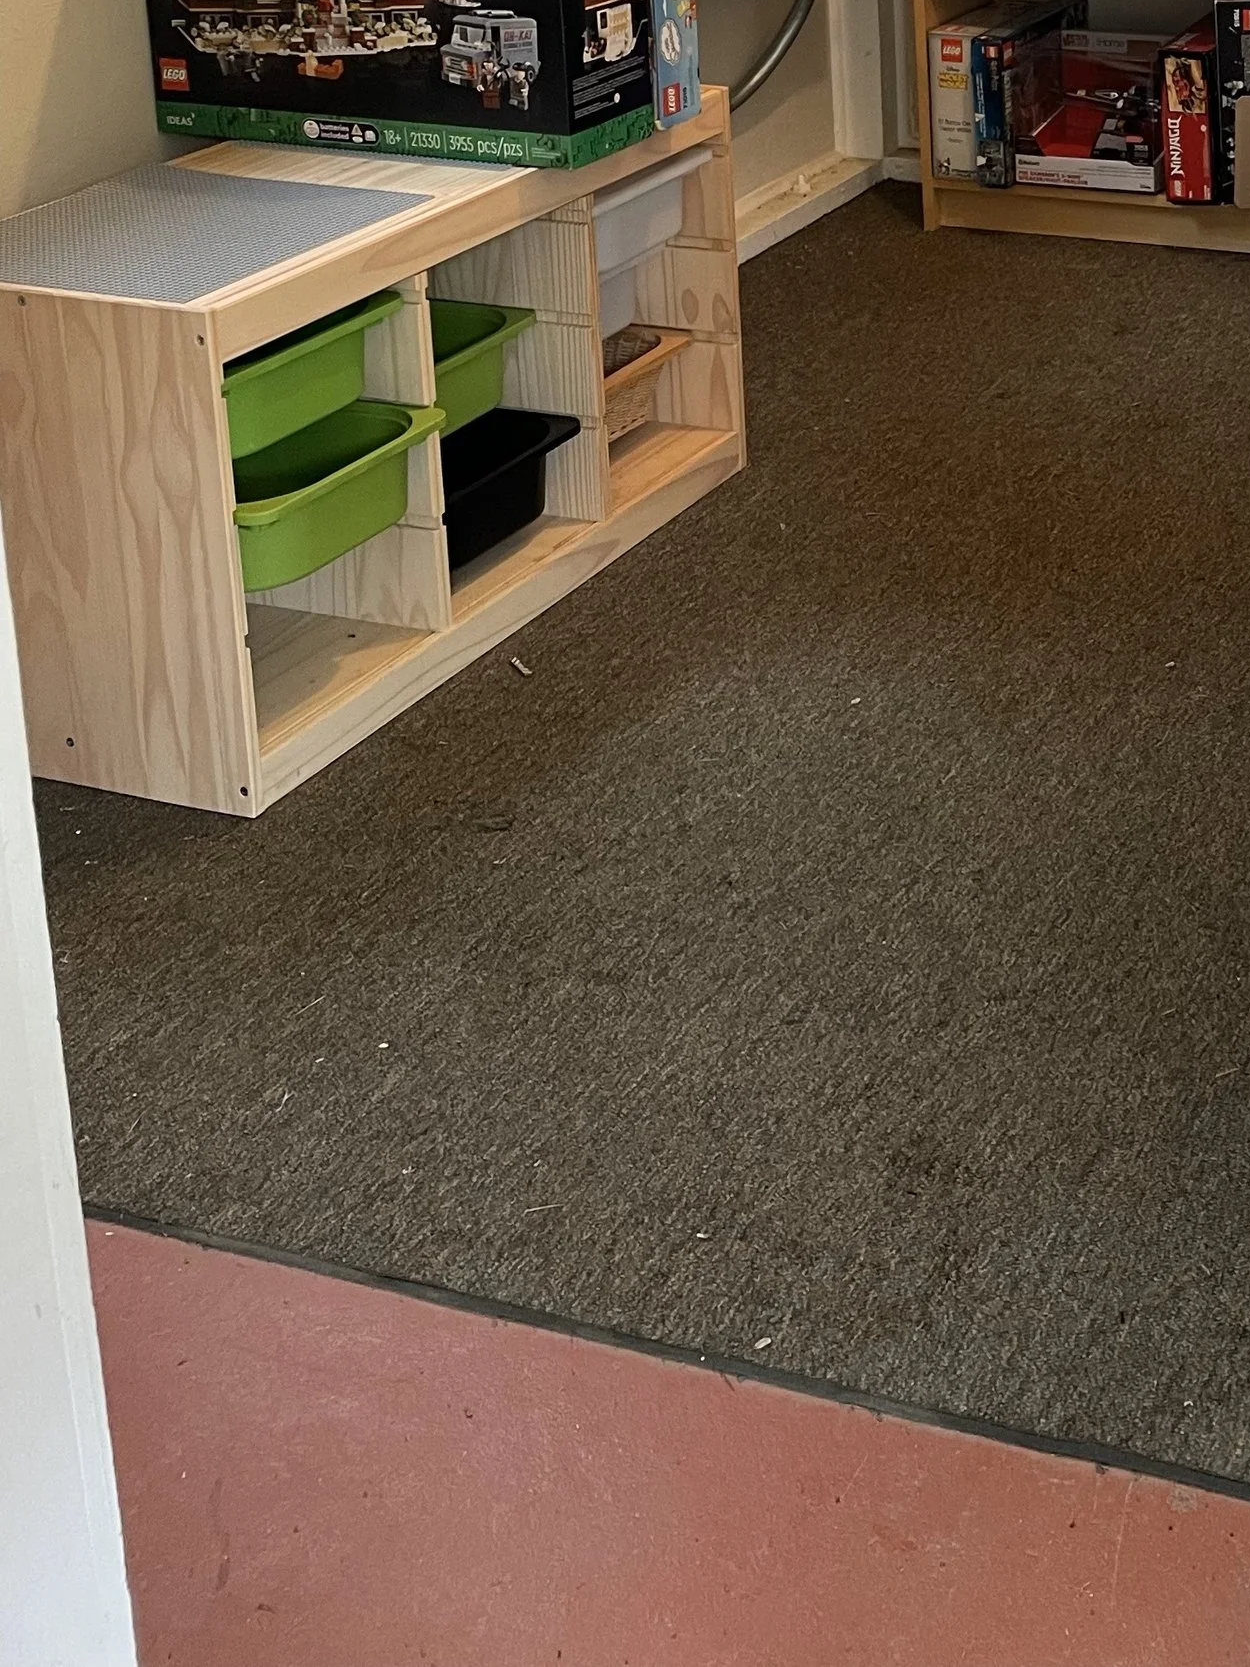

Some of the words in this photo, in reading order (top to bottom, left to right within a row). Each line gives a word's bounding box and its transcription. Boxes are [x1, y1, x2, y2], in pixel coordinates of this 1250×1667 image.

[943, 45, 960, 55] LEGO
[163, 68, 186, 80] LEGO
[668, 86, 676, 113] LEGO
[166, 115, 193, 126] IDEAS
[383, 130, 402, 145] 18+
[410, 133, 441, 149] 21330
[449, 136, 474, 152] 3955
[477, 137, 523, 157] pcs/pzs
[1168, 117, 1184, 177] NINJAGO
